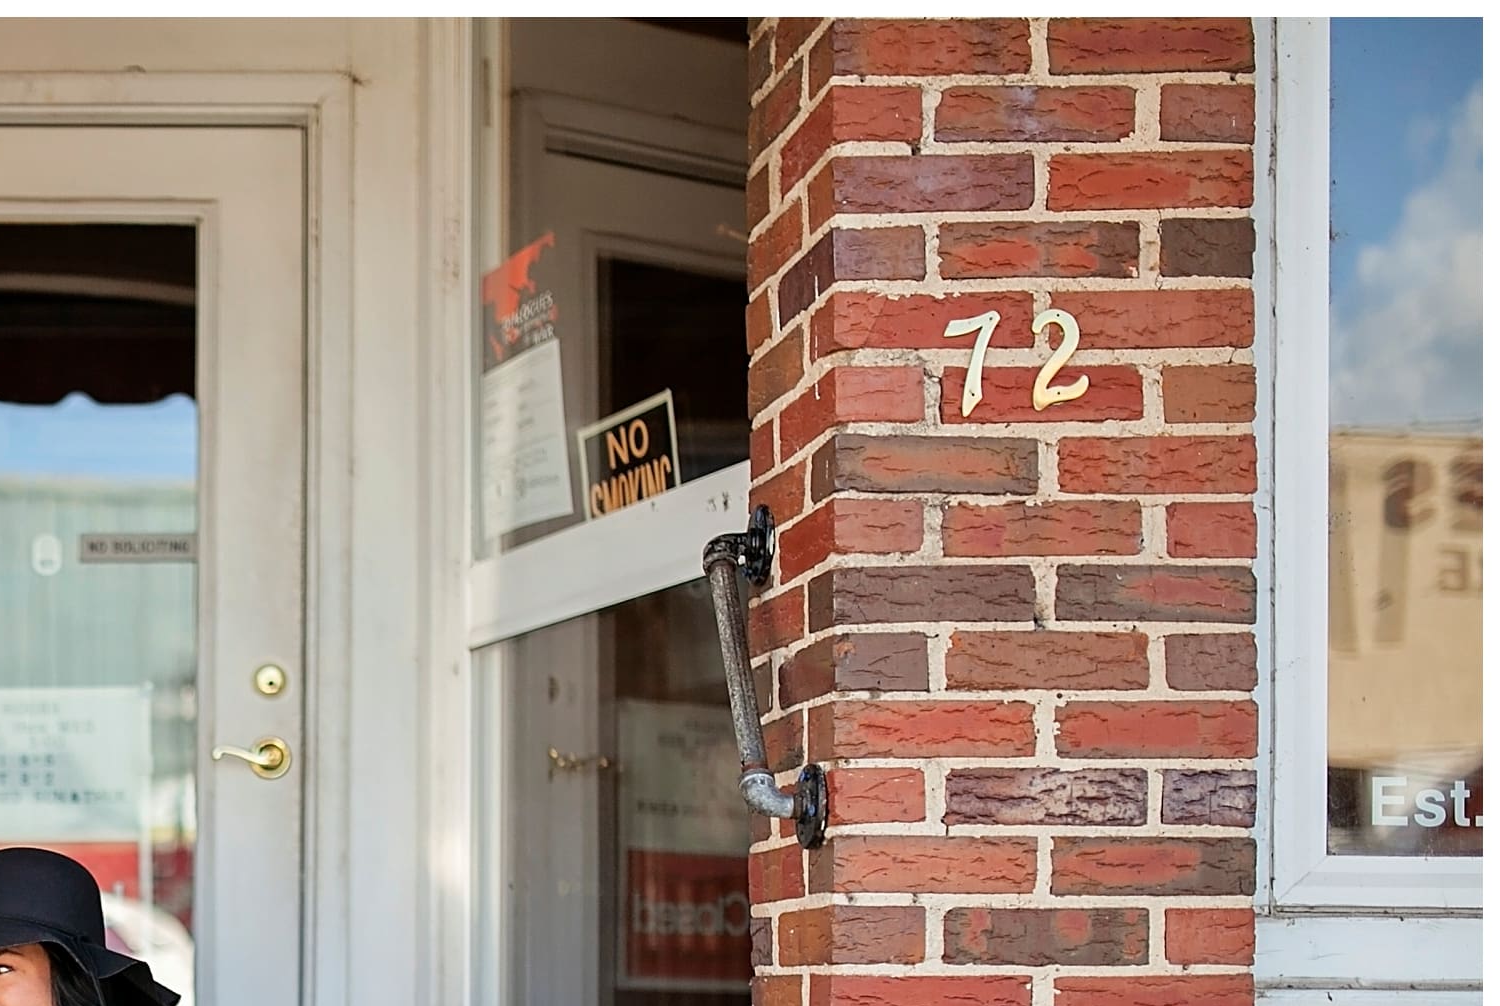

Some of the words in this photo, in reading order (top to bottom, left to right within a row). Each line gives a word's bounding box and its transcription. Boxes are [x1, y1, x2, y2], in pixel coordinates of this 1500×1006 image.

[943, 308, 1090, 418] 72
[605, 418, 650, 470] NO
[88, 541, 108, 554] NO
[1371, 776, 1483, 828] Est.
